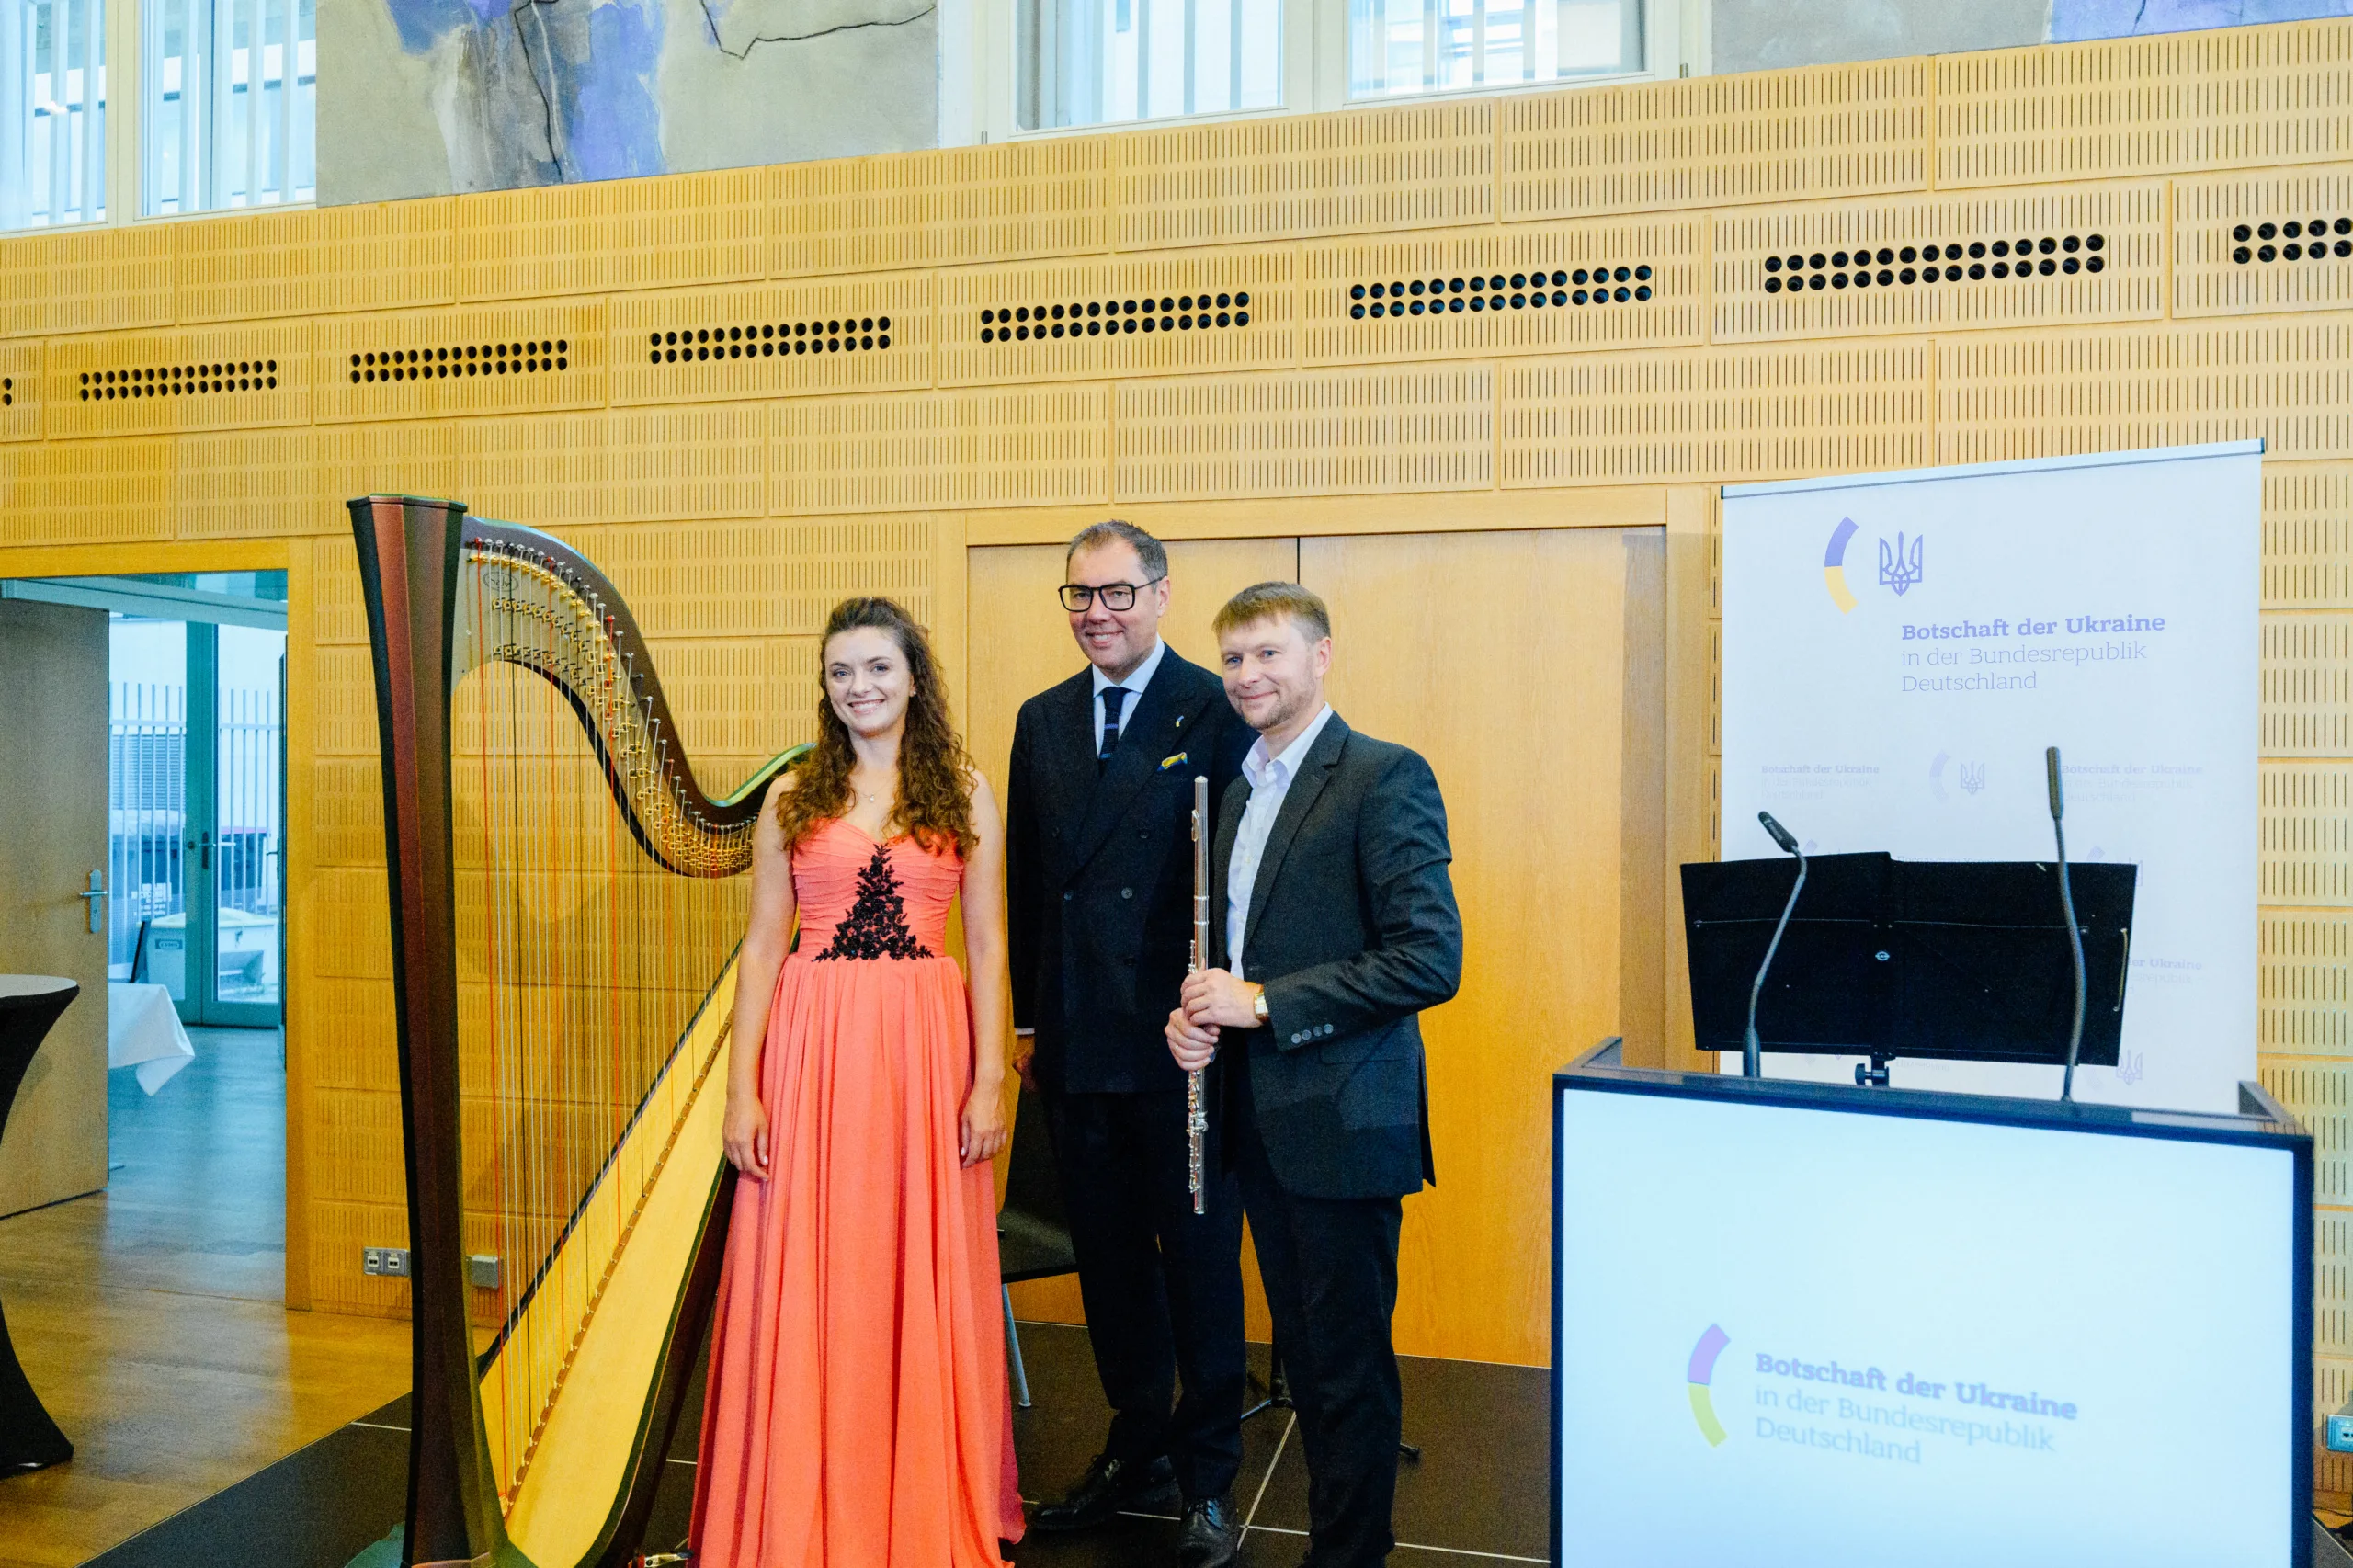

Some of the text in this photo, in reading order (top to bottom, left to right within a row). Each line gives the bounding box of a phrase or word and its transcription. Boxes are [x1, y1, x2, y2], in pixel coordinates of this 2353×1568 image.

[1902, 614, 2165, 642] Botschaft der Ukraine
[1902, 641, 2147, 667] in der Bundesrepublik
[1902, 671, 2038, 693] Deutschland
[1761, 764, 1880, 774] Botschaft der Ukraine
[2124, 763, 2147, 775] der
[2151, 763, 2203, 775] Ukraine
[1756, 1353, 2078, 1421] Botschaft der Ukraine
[1756, 1385, 2057, 1452] in der Bundesrepublik
[1756, 1417, 1922, 1464] Deutschland
